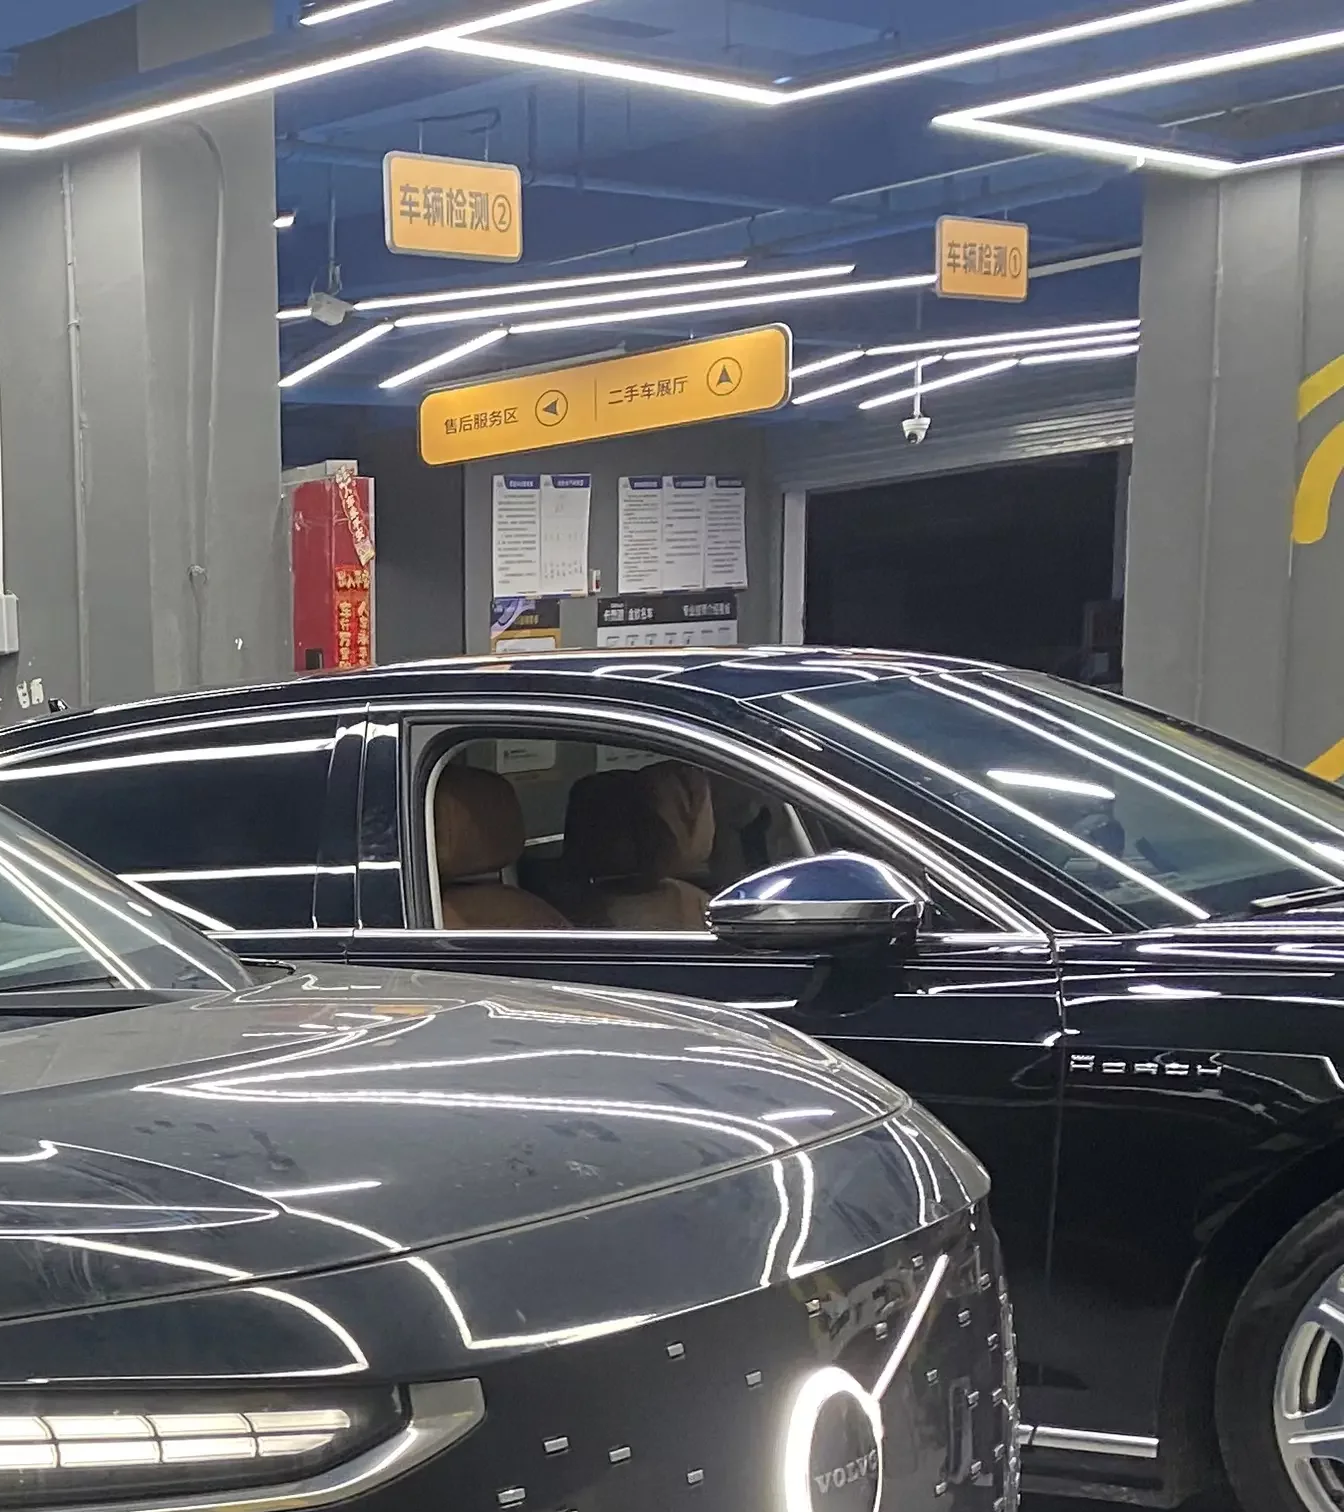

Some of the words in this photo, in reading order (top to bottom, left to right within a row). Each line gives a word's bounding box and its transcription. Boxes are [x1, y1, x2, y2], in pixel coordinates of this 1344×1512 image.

[608, 375, 688, 405] 二手车展厅
[444, 406, 518, 435] 售后服务区
